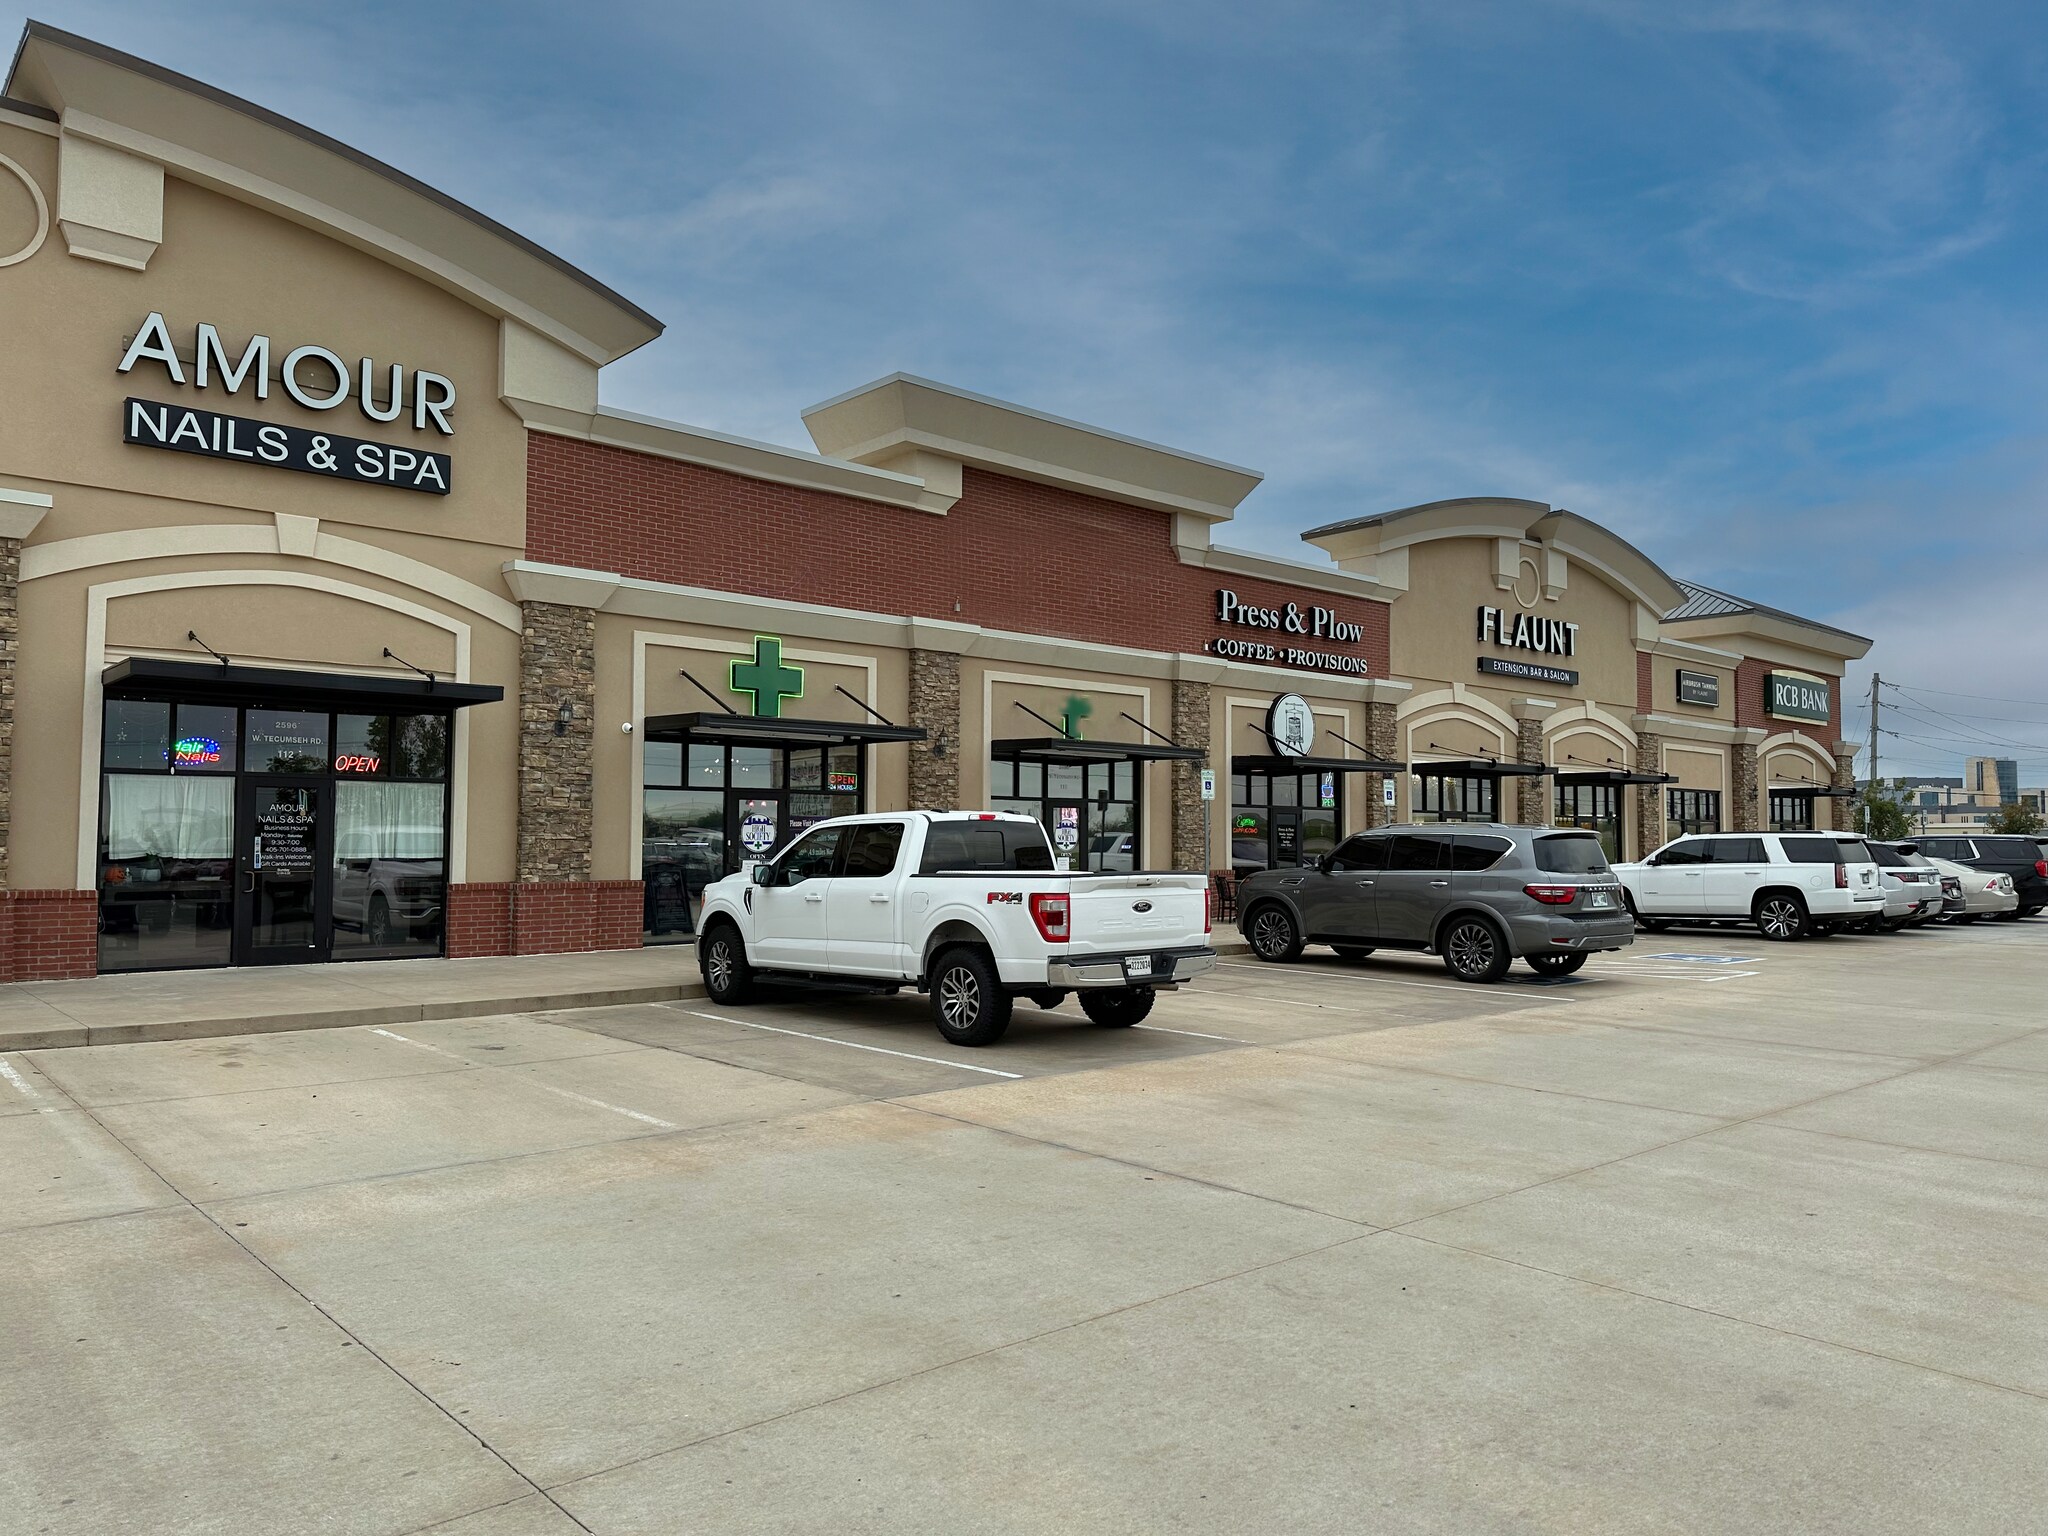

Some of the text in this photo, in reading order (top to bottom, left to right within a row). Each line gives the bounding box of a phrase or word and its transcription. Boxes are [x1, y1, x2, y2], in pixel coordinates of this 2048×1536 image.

[116, 311, 456, 435] AMOUR
[131, 402, 446, 490] NAILS & SPA
[1220, 589, 1364, 643] Press & Plow
[1483, 605, 1579, 656] FLAUNT
[1217, 638, 1368, 674] COFFEE PROVISIONS
[1493, 661, 1570, 682] EXTENSION BAR & SALON
[1776, 683, 1828, 713] RCB BANK
[275, 721, 298, 729] 2596
[264, 735, 308, 744] TECUMSEH
[310, 737, 324, 745] RD.
[176, 751, 220, 763] Nails
[277, 750, 294, 759] 112
[335, 755, 380, 772] OPEN
[829, 774, 855, 784] OPEN
[269, 803, 305, 812] AMOUR
[258, 815, 286, 824] NAILS
[296, 815, 314, 823] SPA
[745, 831, 770, 841] SOCIETY
[987, 892, 1022, 904] FX4
